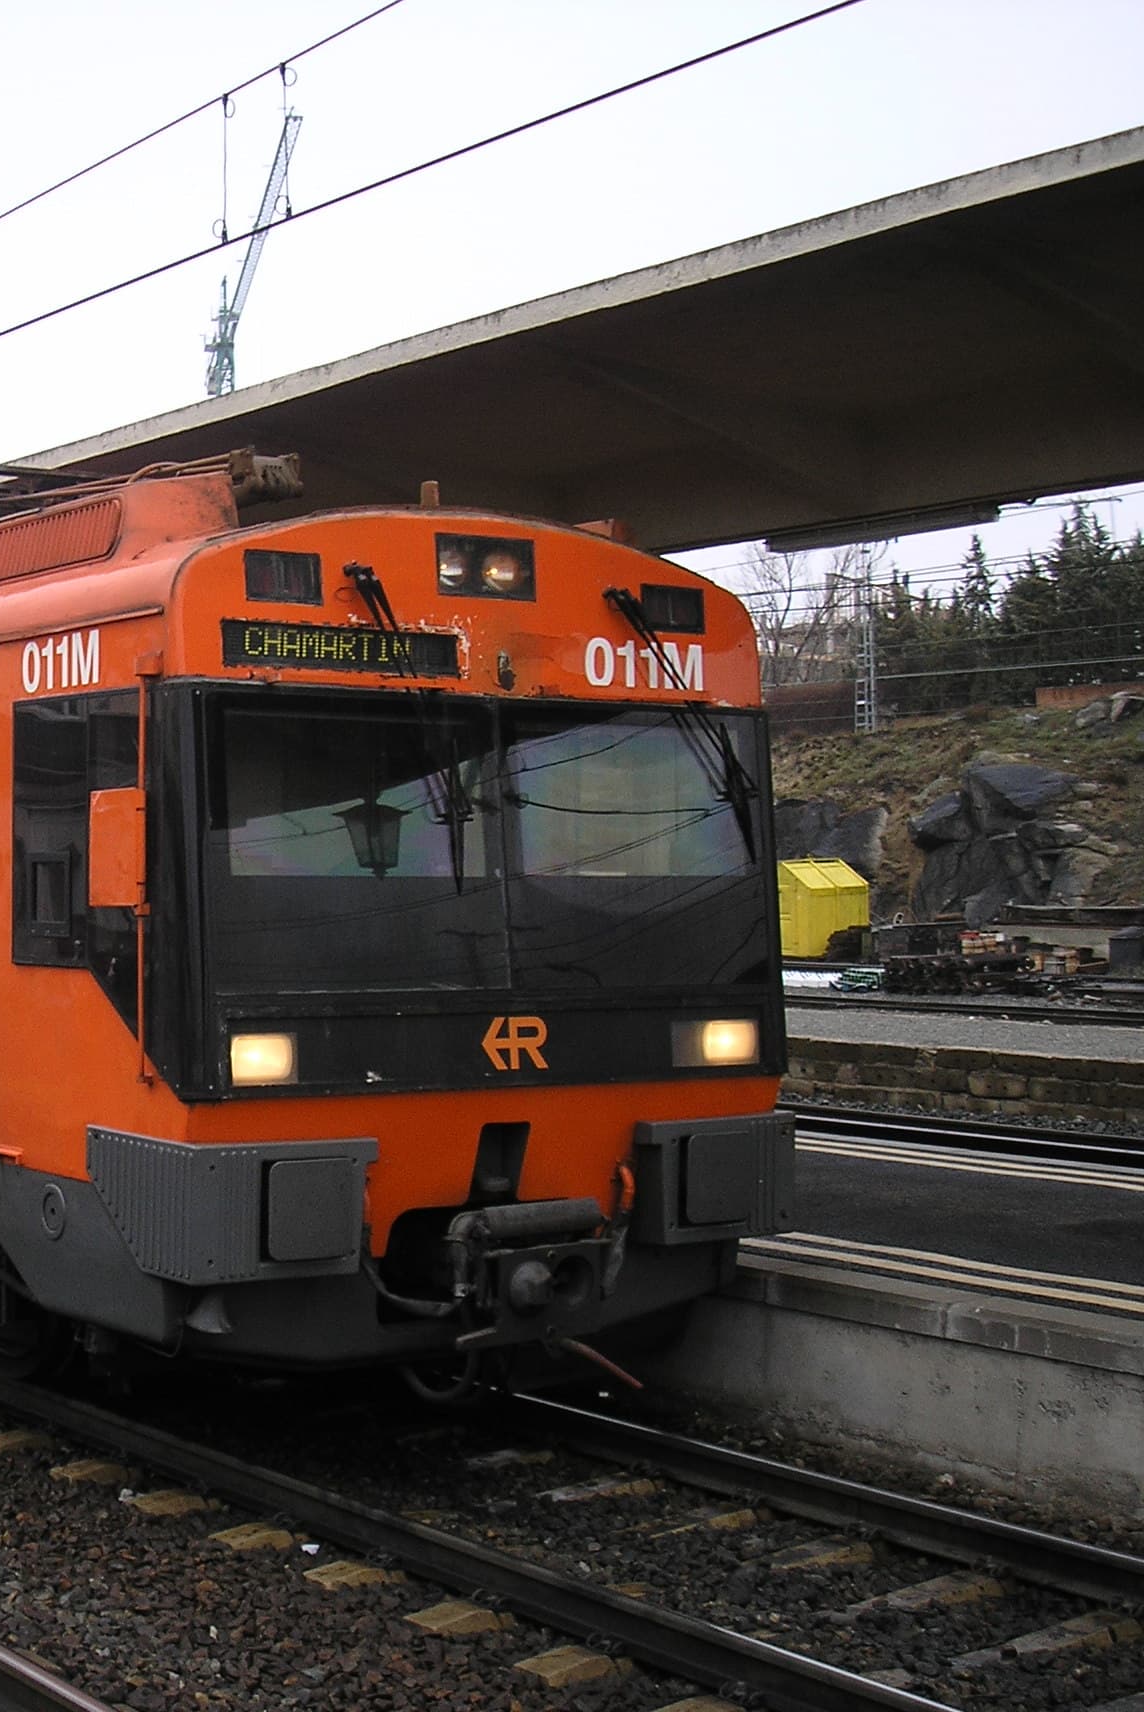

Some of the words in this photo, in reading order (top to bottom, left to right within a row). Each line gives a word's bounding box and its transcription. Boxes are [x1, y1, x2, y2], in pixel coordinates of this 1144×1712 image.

[22, 629, 99, 693] 011M
[244, 626, 411, 663] CHAMARTIN
[584, 637, 704, 691] 011M
